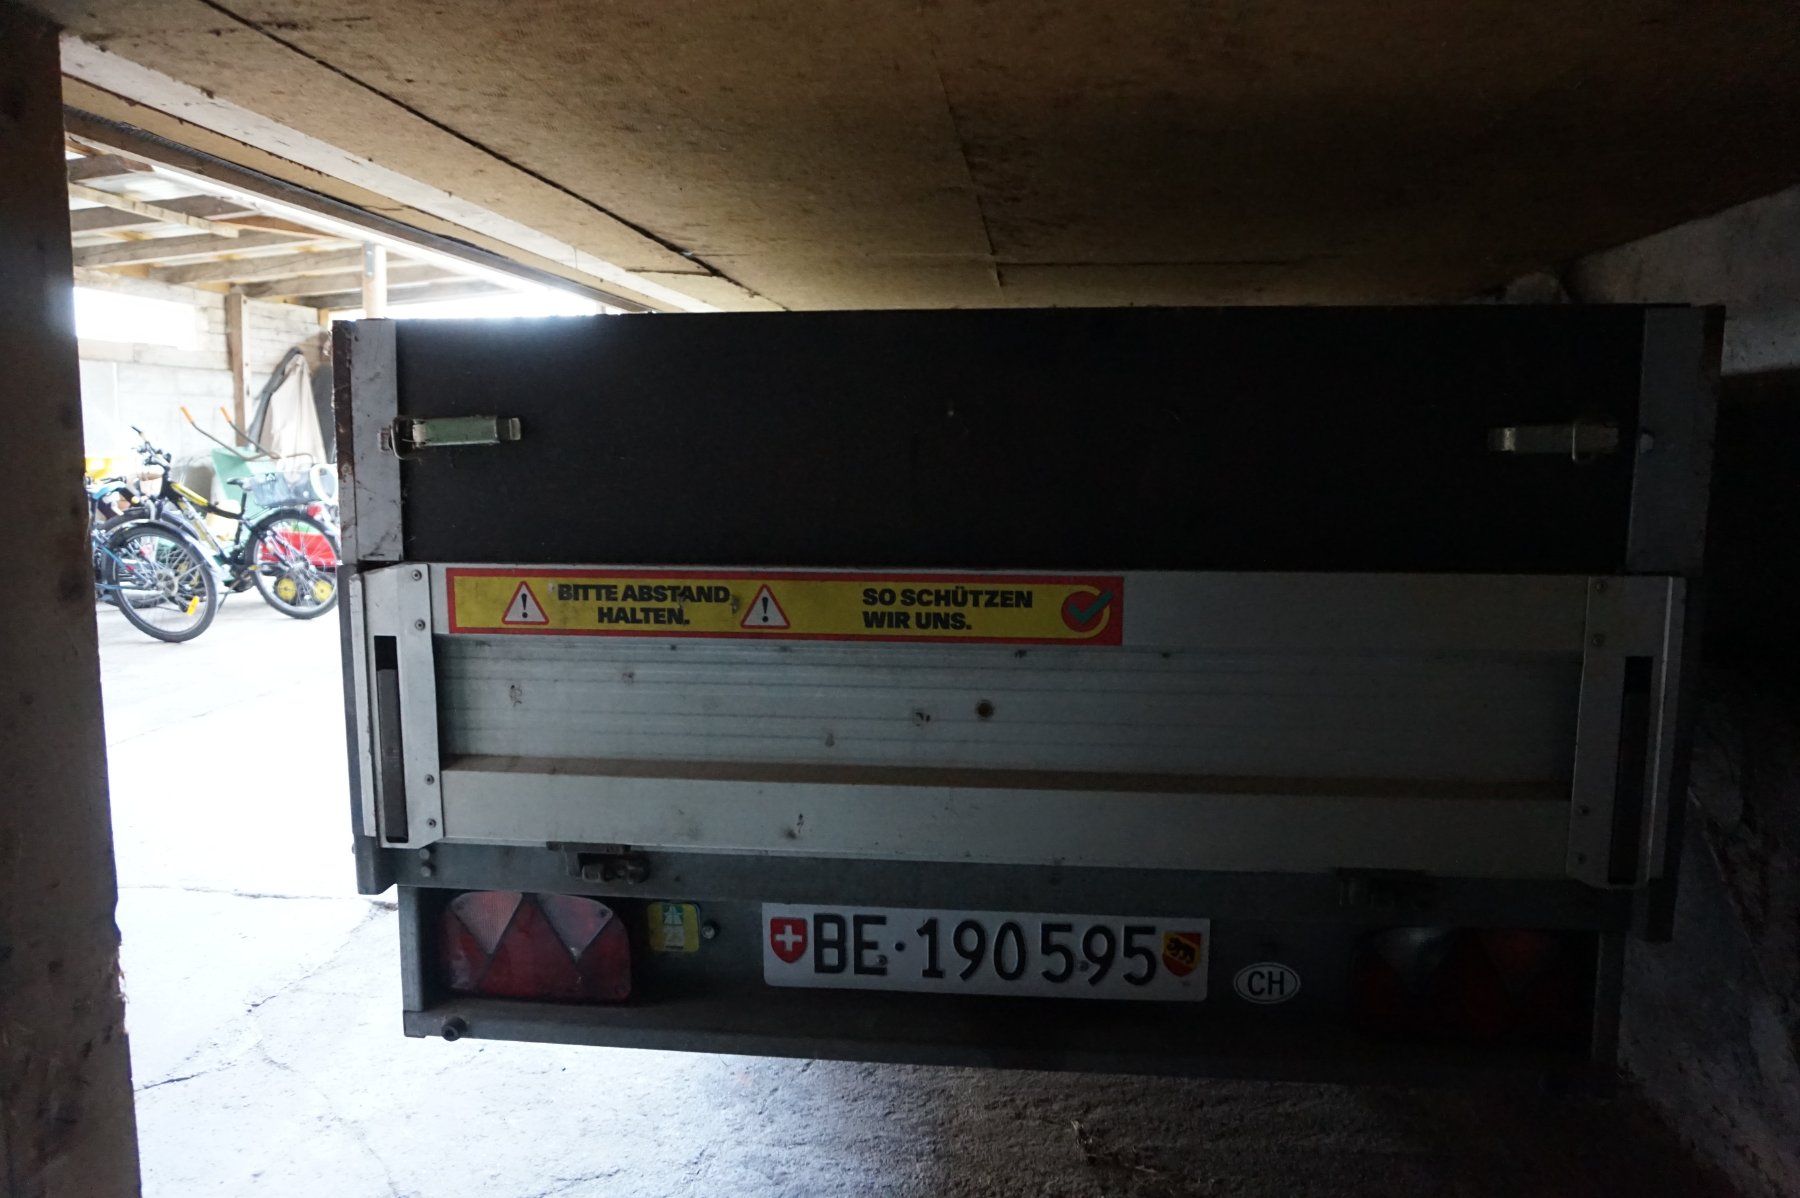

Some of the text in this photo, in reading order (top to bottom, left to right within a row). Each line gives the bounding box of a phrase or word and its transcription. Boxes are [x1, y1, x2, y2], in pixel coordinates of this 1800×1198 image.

[557, 584, 730, 603] BITTE ABSTAND
[862, 586, 1033, 608] SO SCHÜTZEN
[597, 607, 690, 625] HALTEN.
[862, 611, 972, 631] WIR UNS.
[1247, 970, 1286, 996] CH
